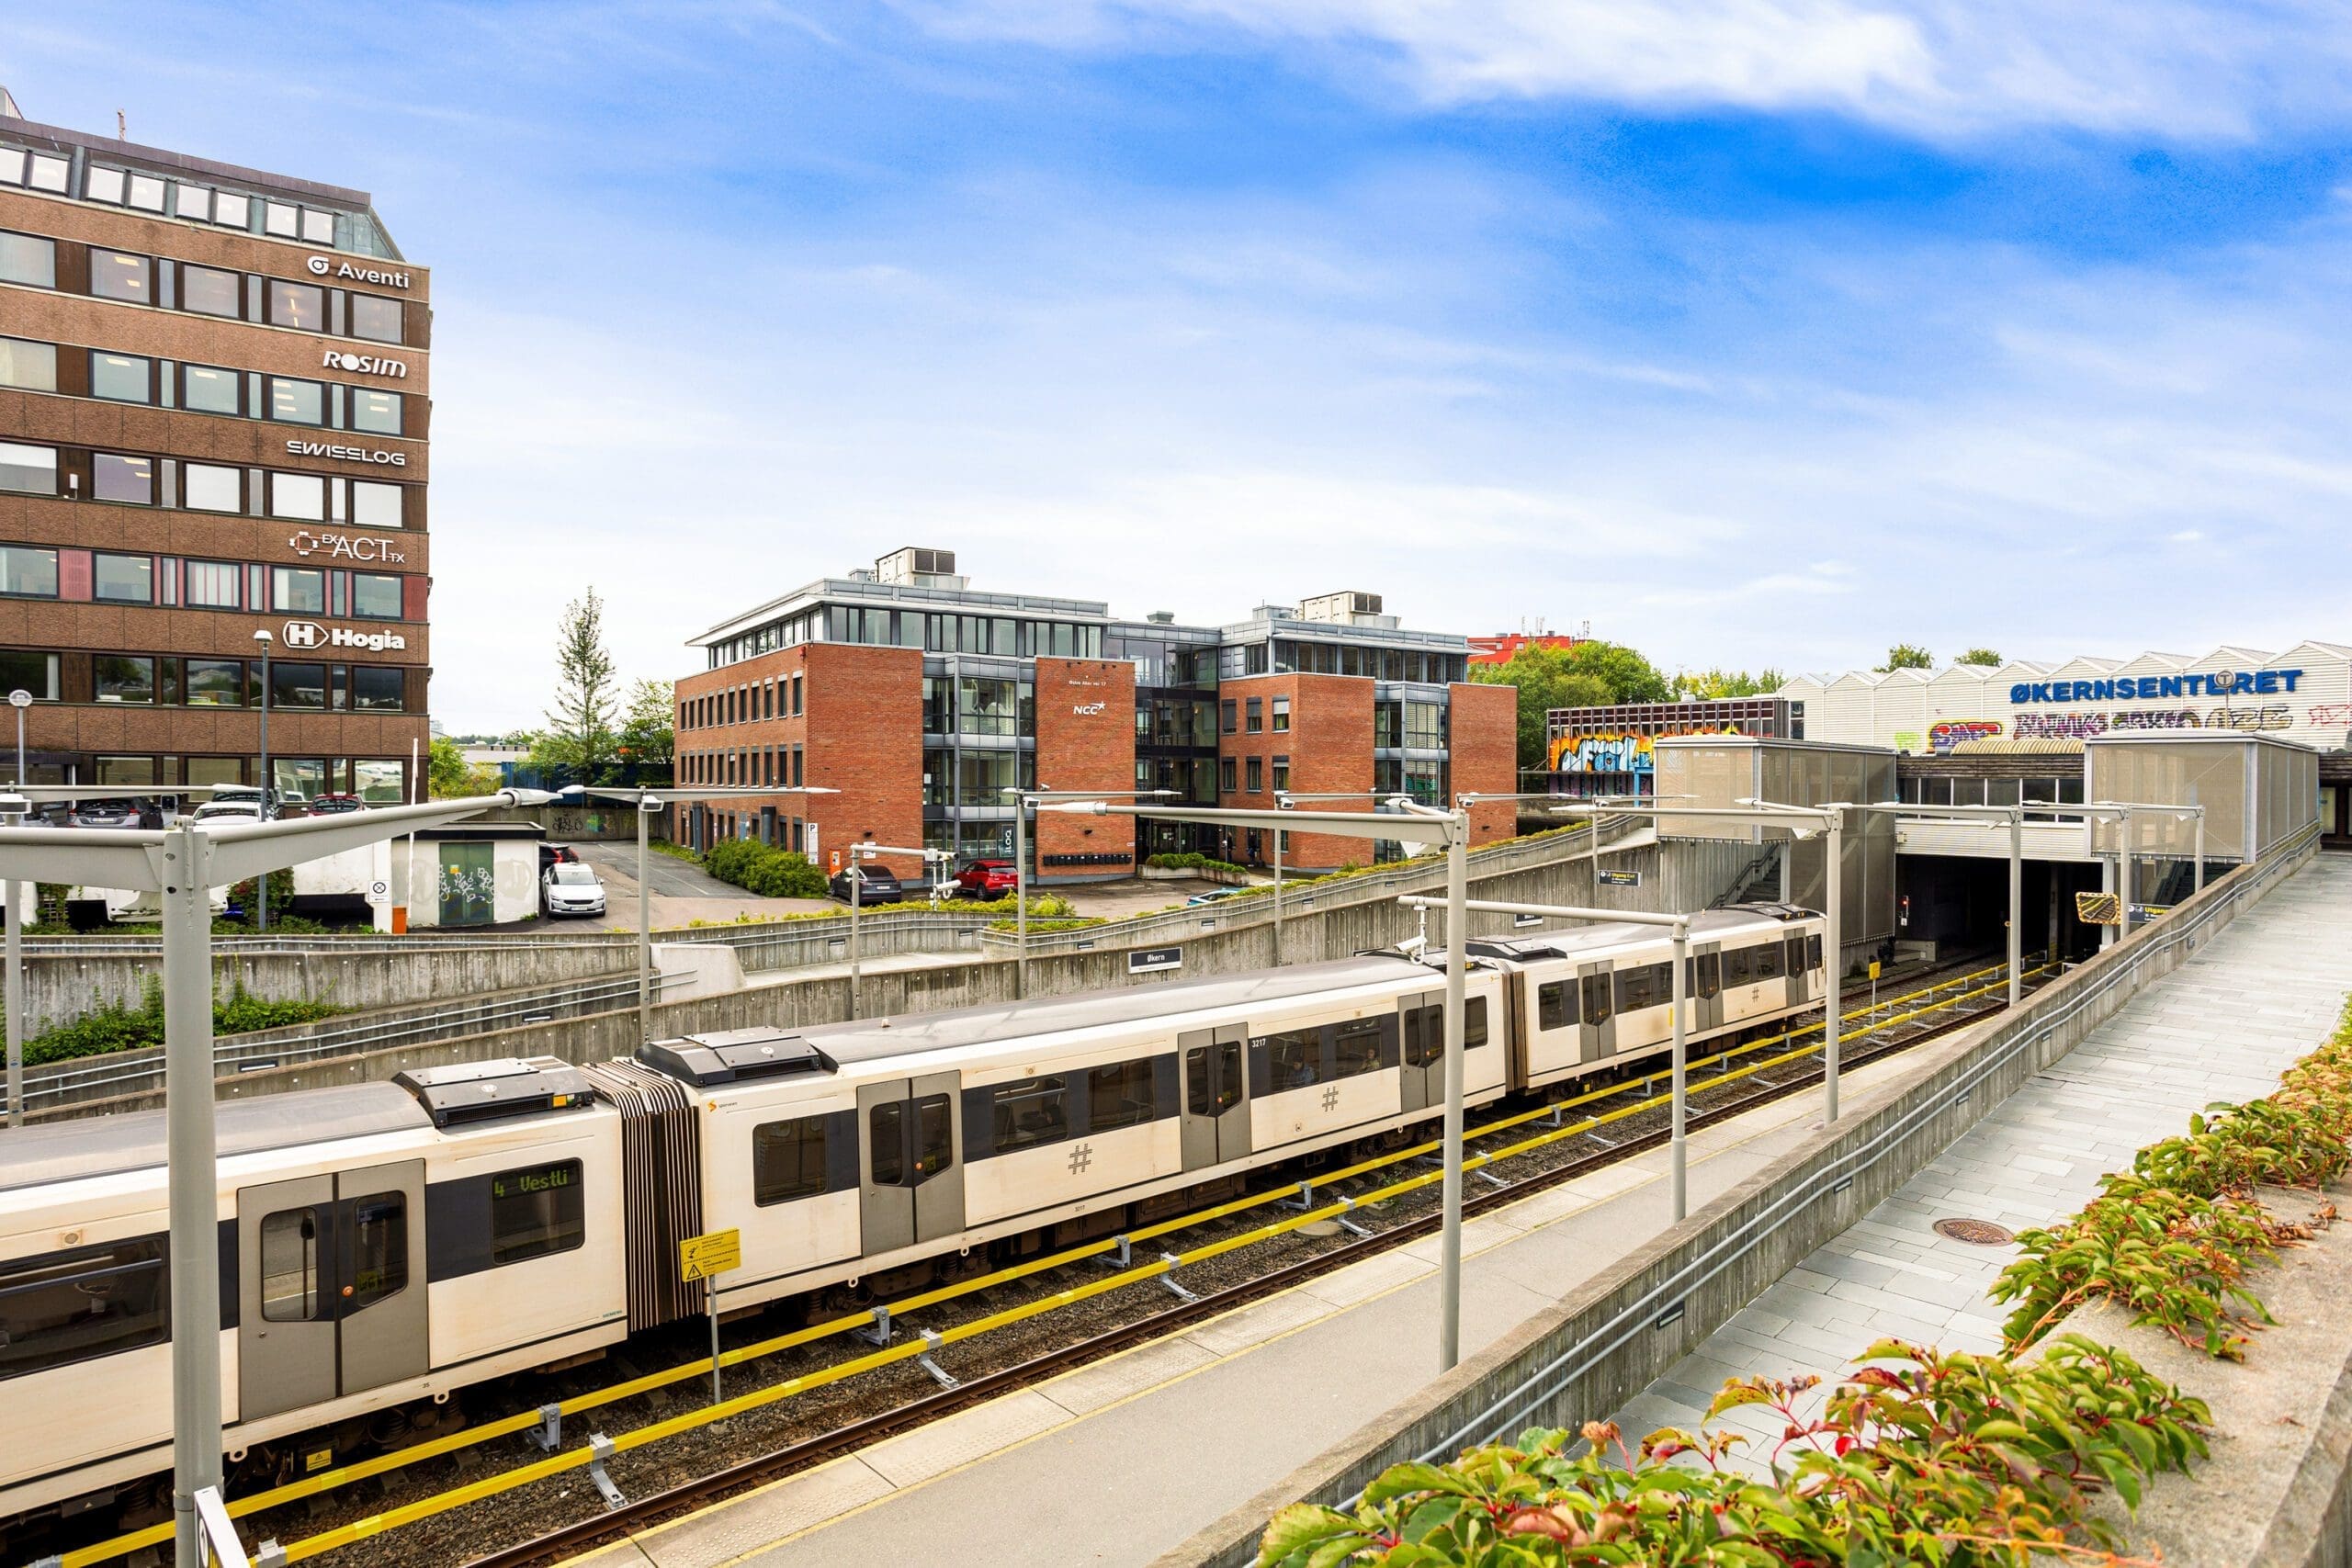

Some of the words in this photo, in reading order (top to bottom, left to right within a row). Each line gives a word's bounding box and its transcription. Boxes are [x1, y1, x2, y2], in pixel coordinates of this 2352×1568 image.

[337, 262, 410, 289] Aventi
[287, 439, 405, 467] SWISSLOG
[332, 627, 405, 651] Hogia
[2009, 669, 2303, 705] ØKERNSENTERET
[1072, 705, 1099, 716] NCC
[809, 824, 816, 832] P
[2144, 906, 2168, 915] Utgan
[1147, 953, 1166, 963] Økern
[1251, 1037, 1266, 1048] 3217
[494, 1180, 505, 1197] 4
[519, 1169, 568, 1192] Vestli
